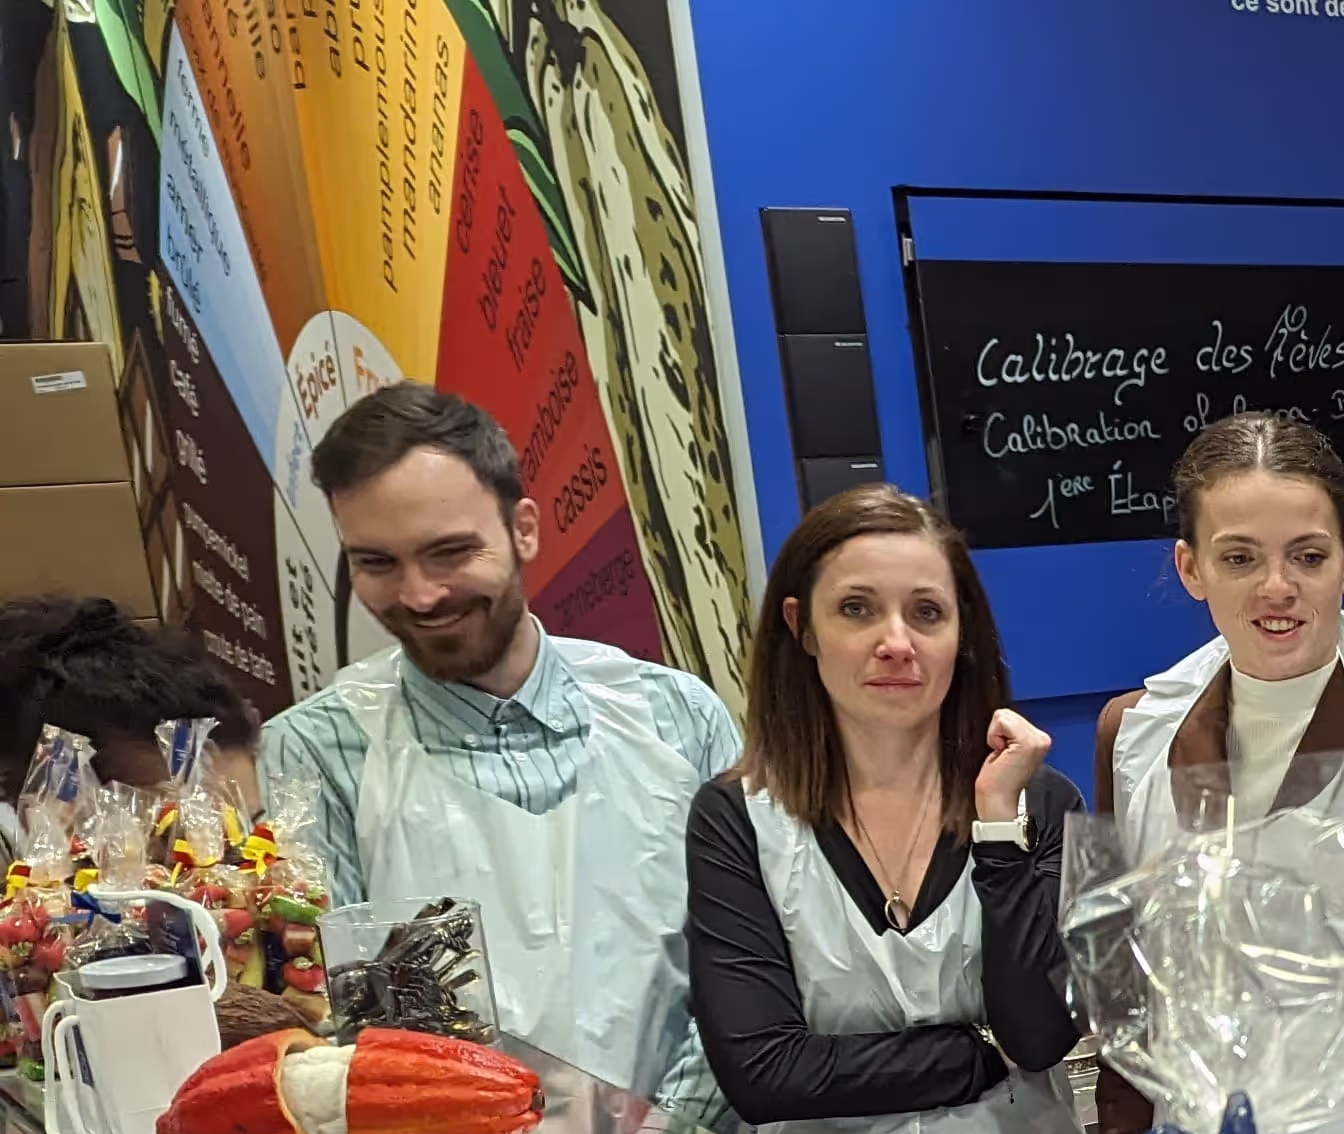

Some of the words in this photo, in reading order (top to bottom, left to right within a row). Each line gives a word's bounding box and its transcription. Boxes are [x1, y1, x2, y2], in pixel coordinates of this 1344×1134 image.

[400, 0, 419, 261] mandarin
[428, 35, 450, 215] ananas
[454, 108, 485, 256] cerise
[505, 257, 546, 374] fraise
[976, 332, 1170, 406] Calibrage
[1195, 320, 1252, 373] des
[982, 414, 1161, 459] Calibration
[552, 444, 609, 534] cassis
[1109, 458, 1178, 522] Étap
